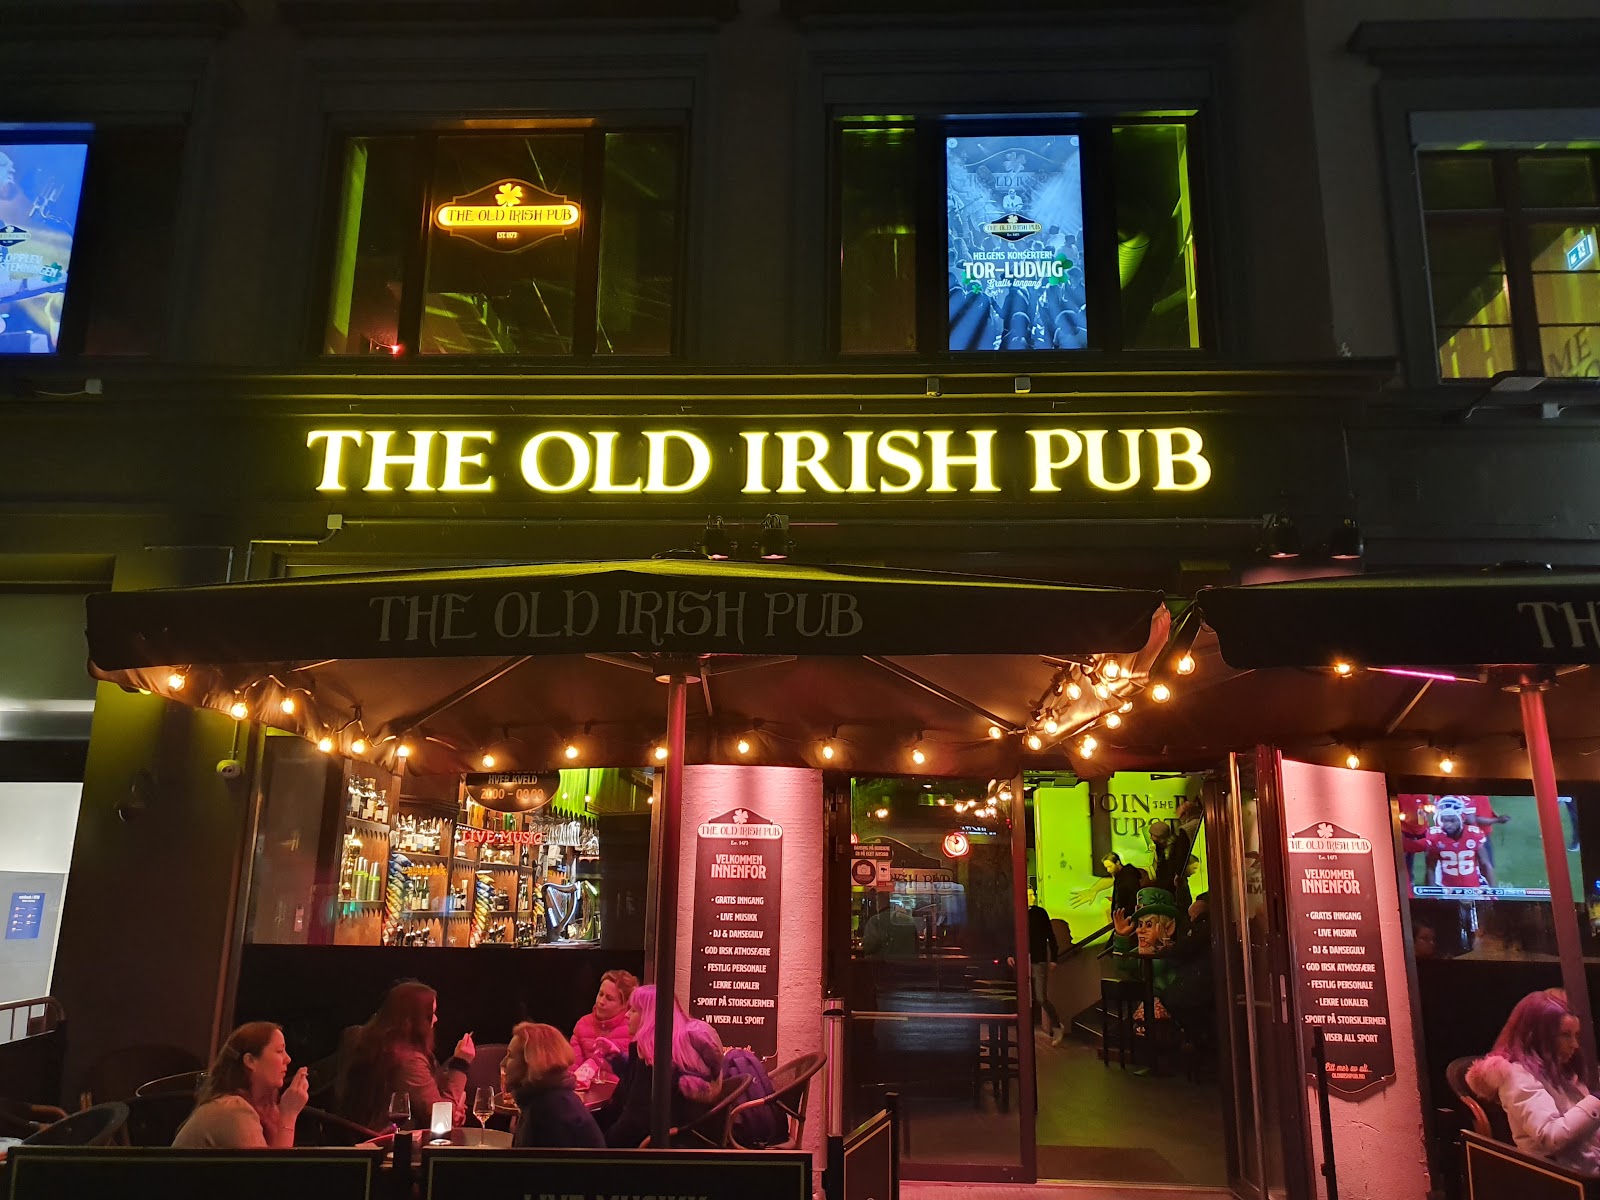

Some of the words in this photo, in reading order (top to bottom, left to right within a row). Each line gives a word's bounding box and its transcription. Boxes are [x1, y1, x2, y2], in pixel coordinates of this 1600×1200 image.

[447, 209, 474, 222] THE
[478, 209, 505, 222] OLD
[509, 209, 543, 224] IRISH
[546, 208, 572, 221] PUB
[972, 251, 1006, 260] HELGENS
[1007, 250, 1053, 260] KONSERTER!
[963, 260, 1064, 279] TOR-LUDVIG
[987, 278, 1012, 290] Gratis
[306, 428, 496, 493] THE
[520, 429, 713, 494] OLD
[738, 429, 1002, 494] IRISH
[1024, 426, 1213, 493] PUB
[369, 592, 477, 648] THE
[493, 590, 600, 639] OLD
[616, 590, 748, 647] IRISH
[763, 590, 864, 638] PUB
[511, 774, 538, 785] KVELD
[1088, 793, 1150, 817] JOIN
[1152, 800, 1174, 809] THE
[461, 830, 495, 844] LIVE
[701, 826, 718, 835] THE
[720, 826, 738, 835] OLD
[740, 826, 762, 837] IRISH
[763, 827, 780, 837] PUB
[1306, 840, 1324, 850] OLD
[1326, 840, 1350, 851] IRISH
[1351, 841, 1369, 851] PUB
[715, 853, 763, 865] VELKOMMEN
[1440, 850, 1475, 876] 26
[711, 864, 767, 879] INNENFOR
[1304, 868, 1355, 880] VELKOMMEN
[1301, 879, 1361, 894] INNENFOR
[715, 896, 736, 905] GRATIS
[737, 896, 764, 906] INNGANG
[720, 912, 733, 921] LIVE
[734, 913, 758, 922] MUSIKK
[1310, 911, 1332, 920] GRATIS
[1333, 911, 1362, 921] INNGANG
[713, 929, 721, 938] DJ
[722, 929, 728, 938] &
[729, 930, 764, 939] DANSEGULV
[1317, 928, 1332, 937] LIVE
[1332, 928, 1358, 937] MUSIKK
[704, 946, 718, 955] GOD
[718, 946, 733, 955] IRSK
[734, 947, 771, 956] ATMOSFÆRE
[1312, 945, 1321, 954] DJ
[1322, 945, 1328, 954] &
[1329, 945, 1366, 955] DANSEGULV
[707, 963, 731, 972] FESTLIG
[732, 963, 767, 973] PERSONALE
[1305, 962, 1320, 971] GOD
[1321, 962, 1336, 972] IRSK
[1336, 963, 1376, 973] ATMOSFÆRE
[713, 980, 732, 990] LEKRE
[733, 981, 760, 991] LOKALER
[1311, 980, 1336, 989] FESTLIG
[1337, 980, 1374, 990] PERSONALE
[697, 997, 717, 1006] SPORT
[718, 995, 727, 1007] PÅ
[727, 998, 775, 1008] STORSKJERMER
[1319, 997, 1339, 1007] LEKRE
[1340, 998, 1369, 1007] LOKALER
[705, 1014, 712, 1023] VI
[713, 1015, 731, 1024] VISER
[732, 1015, 743, 1024] ALL
[744, 1016, 765, 1025] SPORT
[1305, 1014, 1326, 1024] SPORT
[1326, 1012, 1337, 1024] PÅ
[1337, 1015, 1387, 1026] STORSKJERMER
[1323, 1032, 1343, 1042] VISER
[1344, 1033, 1356, 1042] ALL
[1356, 1034, 1378, 1043] SPORT
